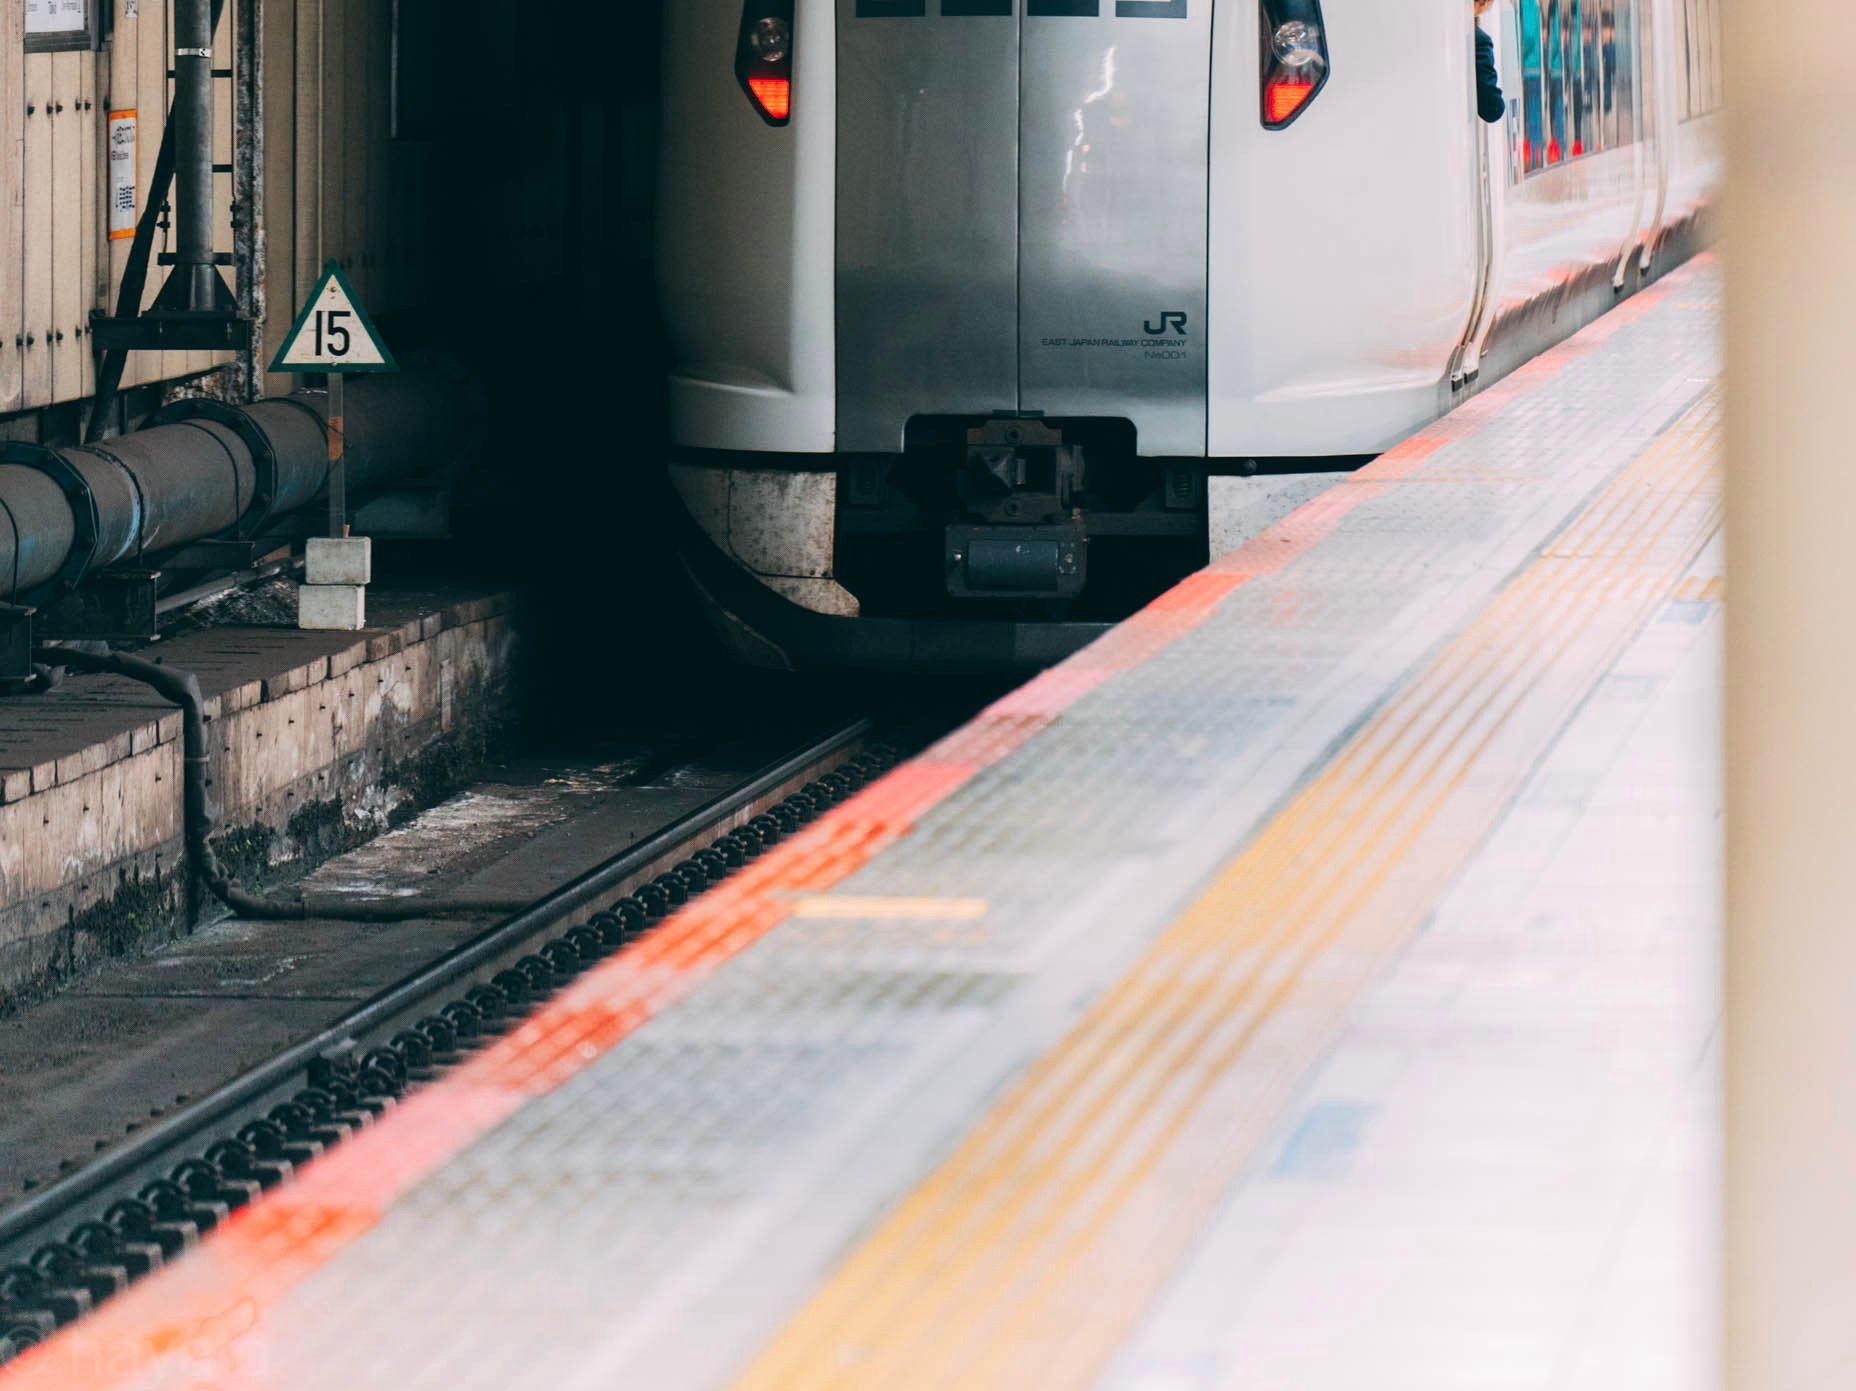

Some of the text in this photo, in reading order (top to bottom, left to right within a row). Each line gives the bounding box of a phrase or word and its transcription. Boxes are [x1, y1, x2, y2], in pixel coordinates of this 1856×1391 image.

[315, 310, 351, 357] 15
[1143, 311, 1187, 335] JR
[1041, 338, 1186, 347] EAST JAPAN RAILWAY COMPANY
